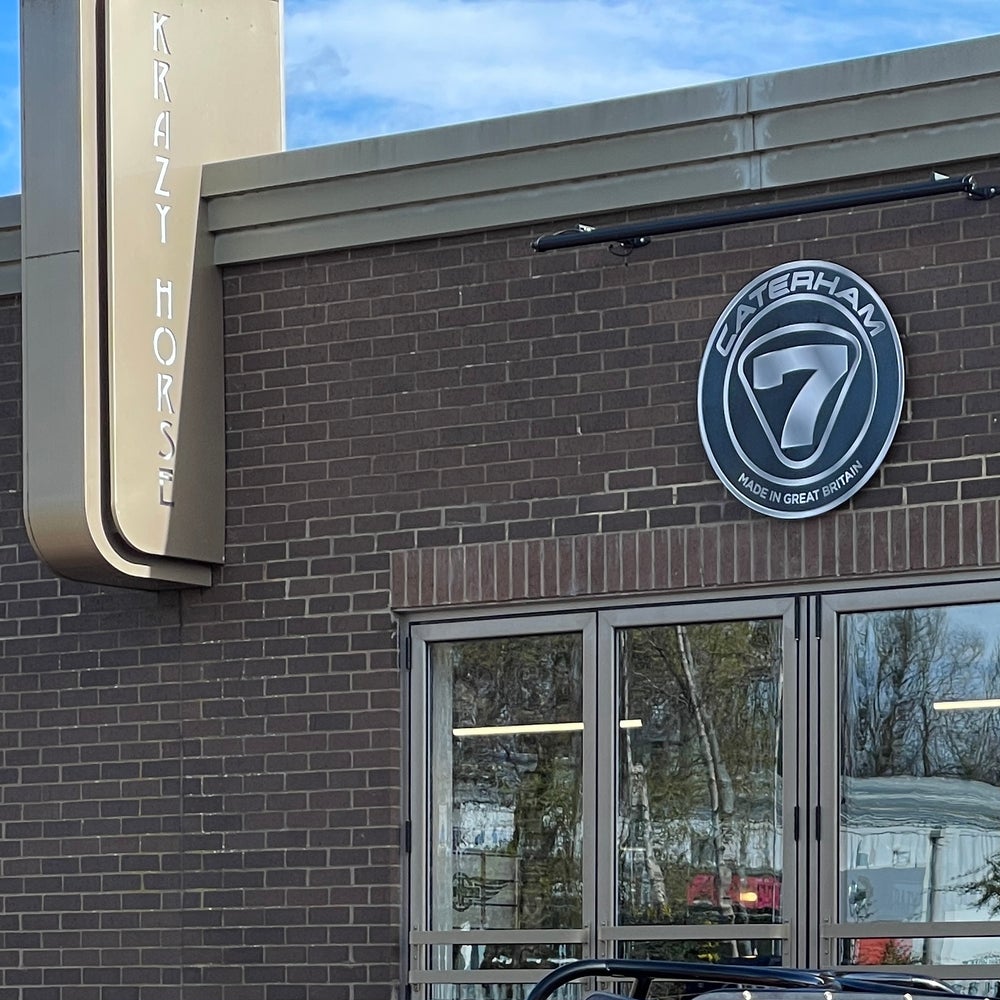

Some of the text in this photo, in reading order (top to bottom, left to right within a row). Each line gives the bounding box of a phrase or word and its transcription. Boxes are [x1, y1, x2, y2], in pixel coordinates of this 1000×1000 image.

[152, 11, 178, 507] KRAZY HORSE
[716, 271, 886, 357] CATERHAM
[752, 344, 849, 450] 7
[738, 460, 863, 504] MADE IN GREAT BRITAIN
